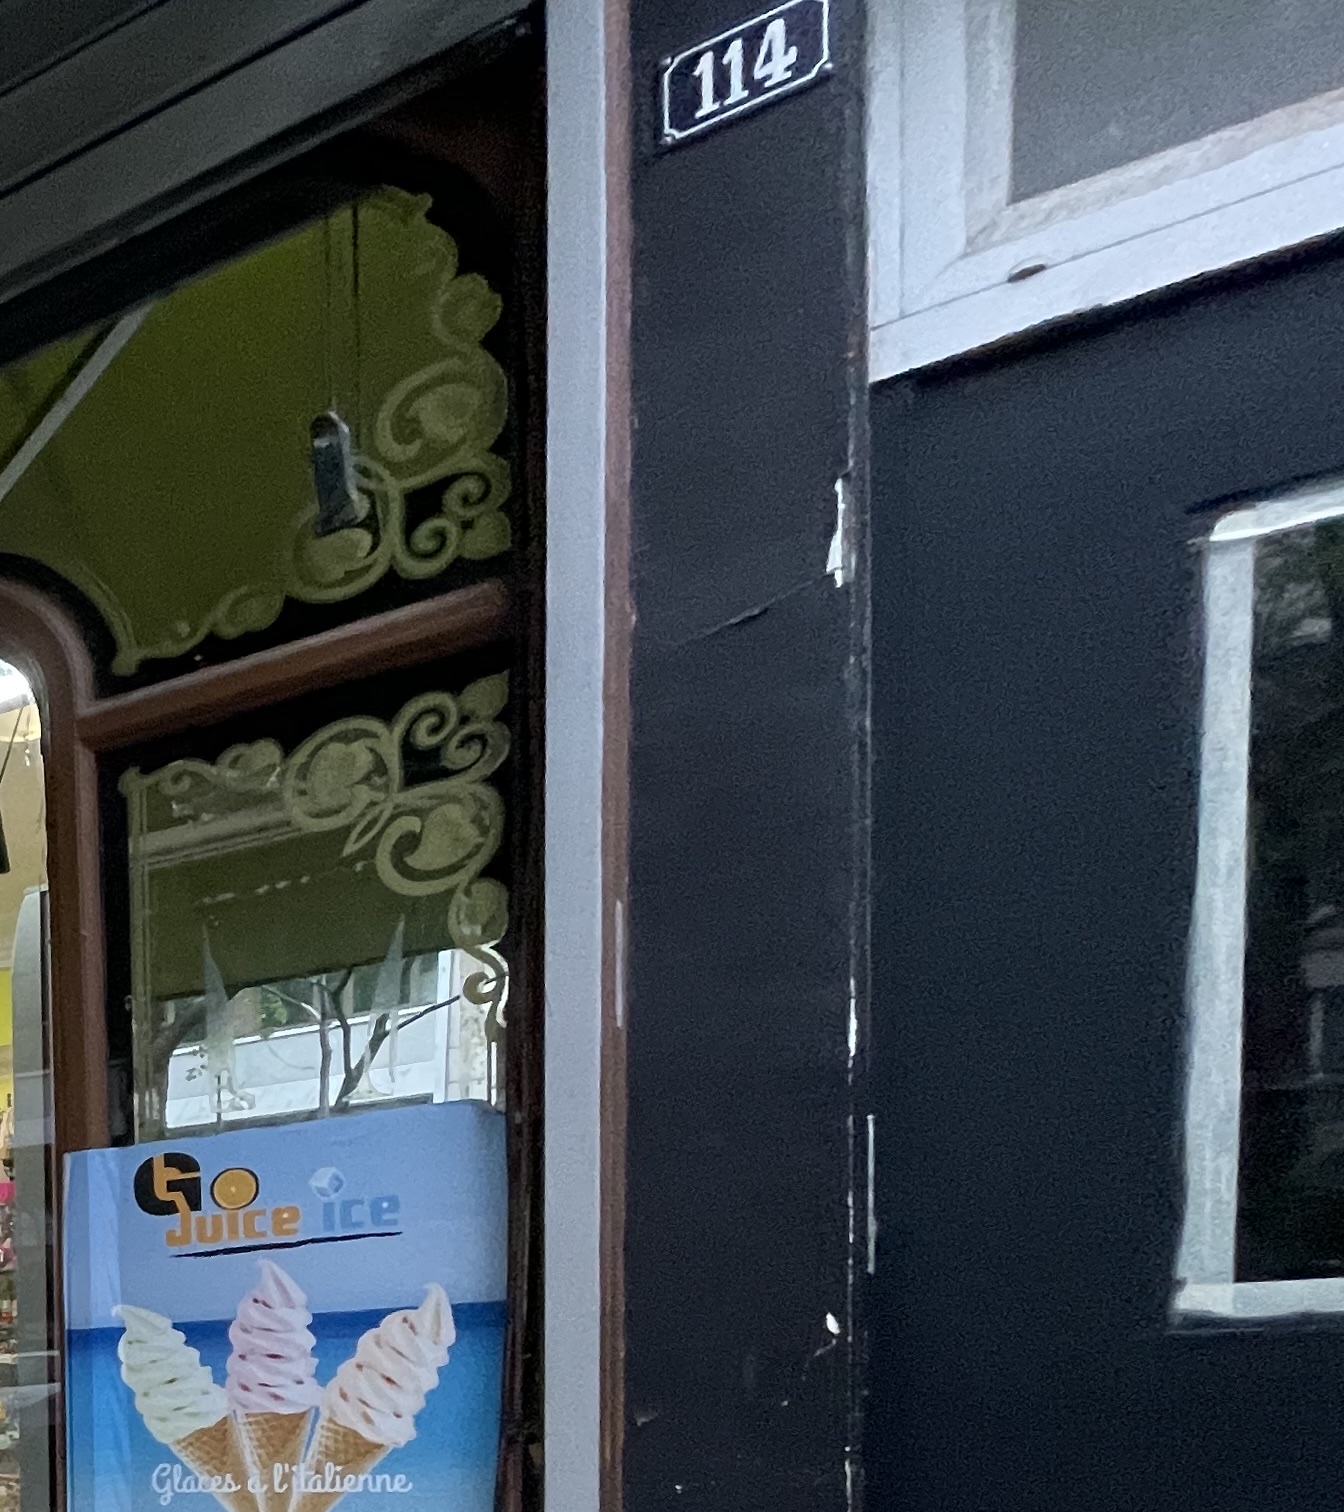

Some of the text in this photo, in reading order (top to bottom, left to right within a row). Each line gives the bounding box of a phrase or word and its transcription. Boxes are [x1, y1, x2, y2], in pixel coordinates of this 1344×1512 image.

[692, 18, 798, 120] 114
[133, 1152, 260, 1216] Go
[165, 1177, 400, 1247] Juice ice
[152, 1463, 241, 1505] Glaces
